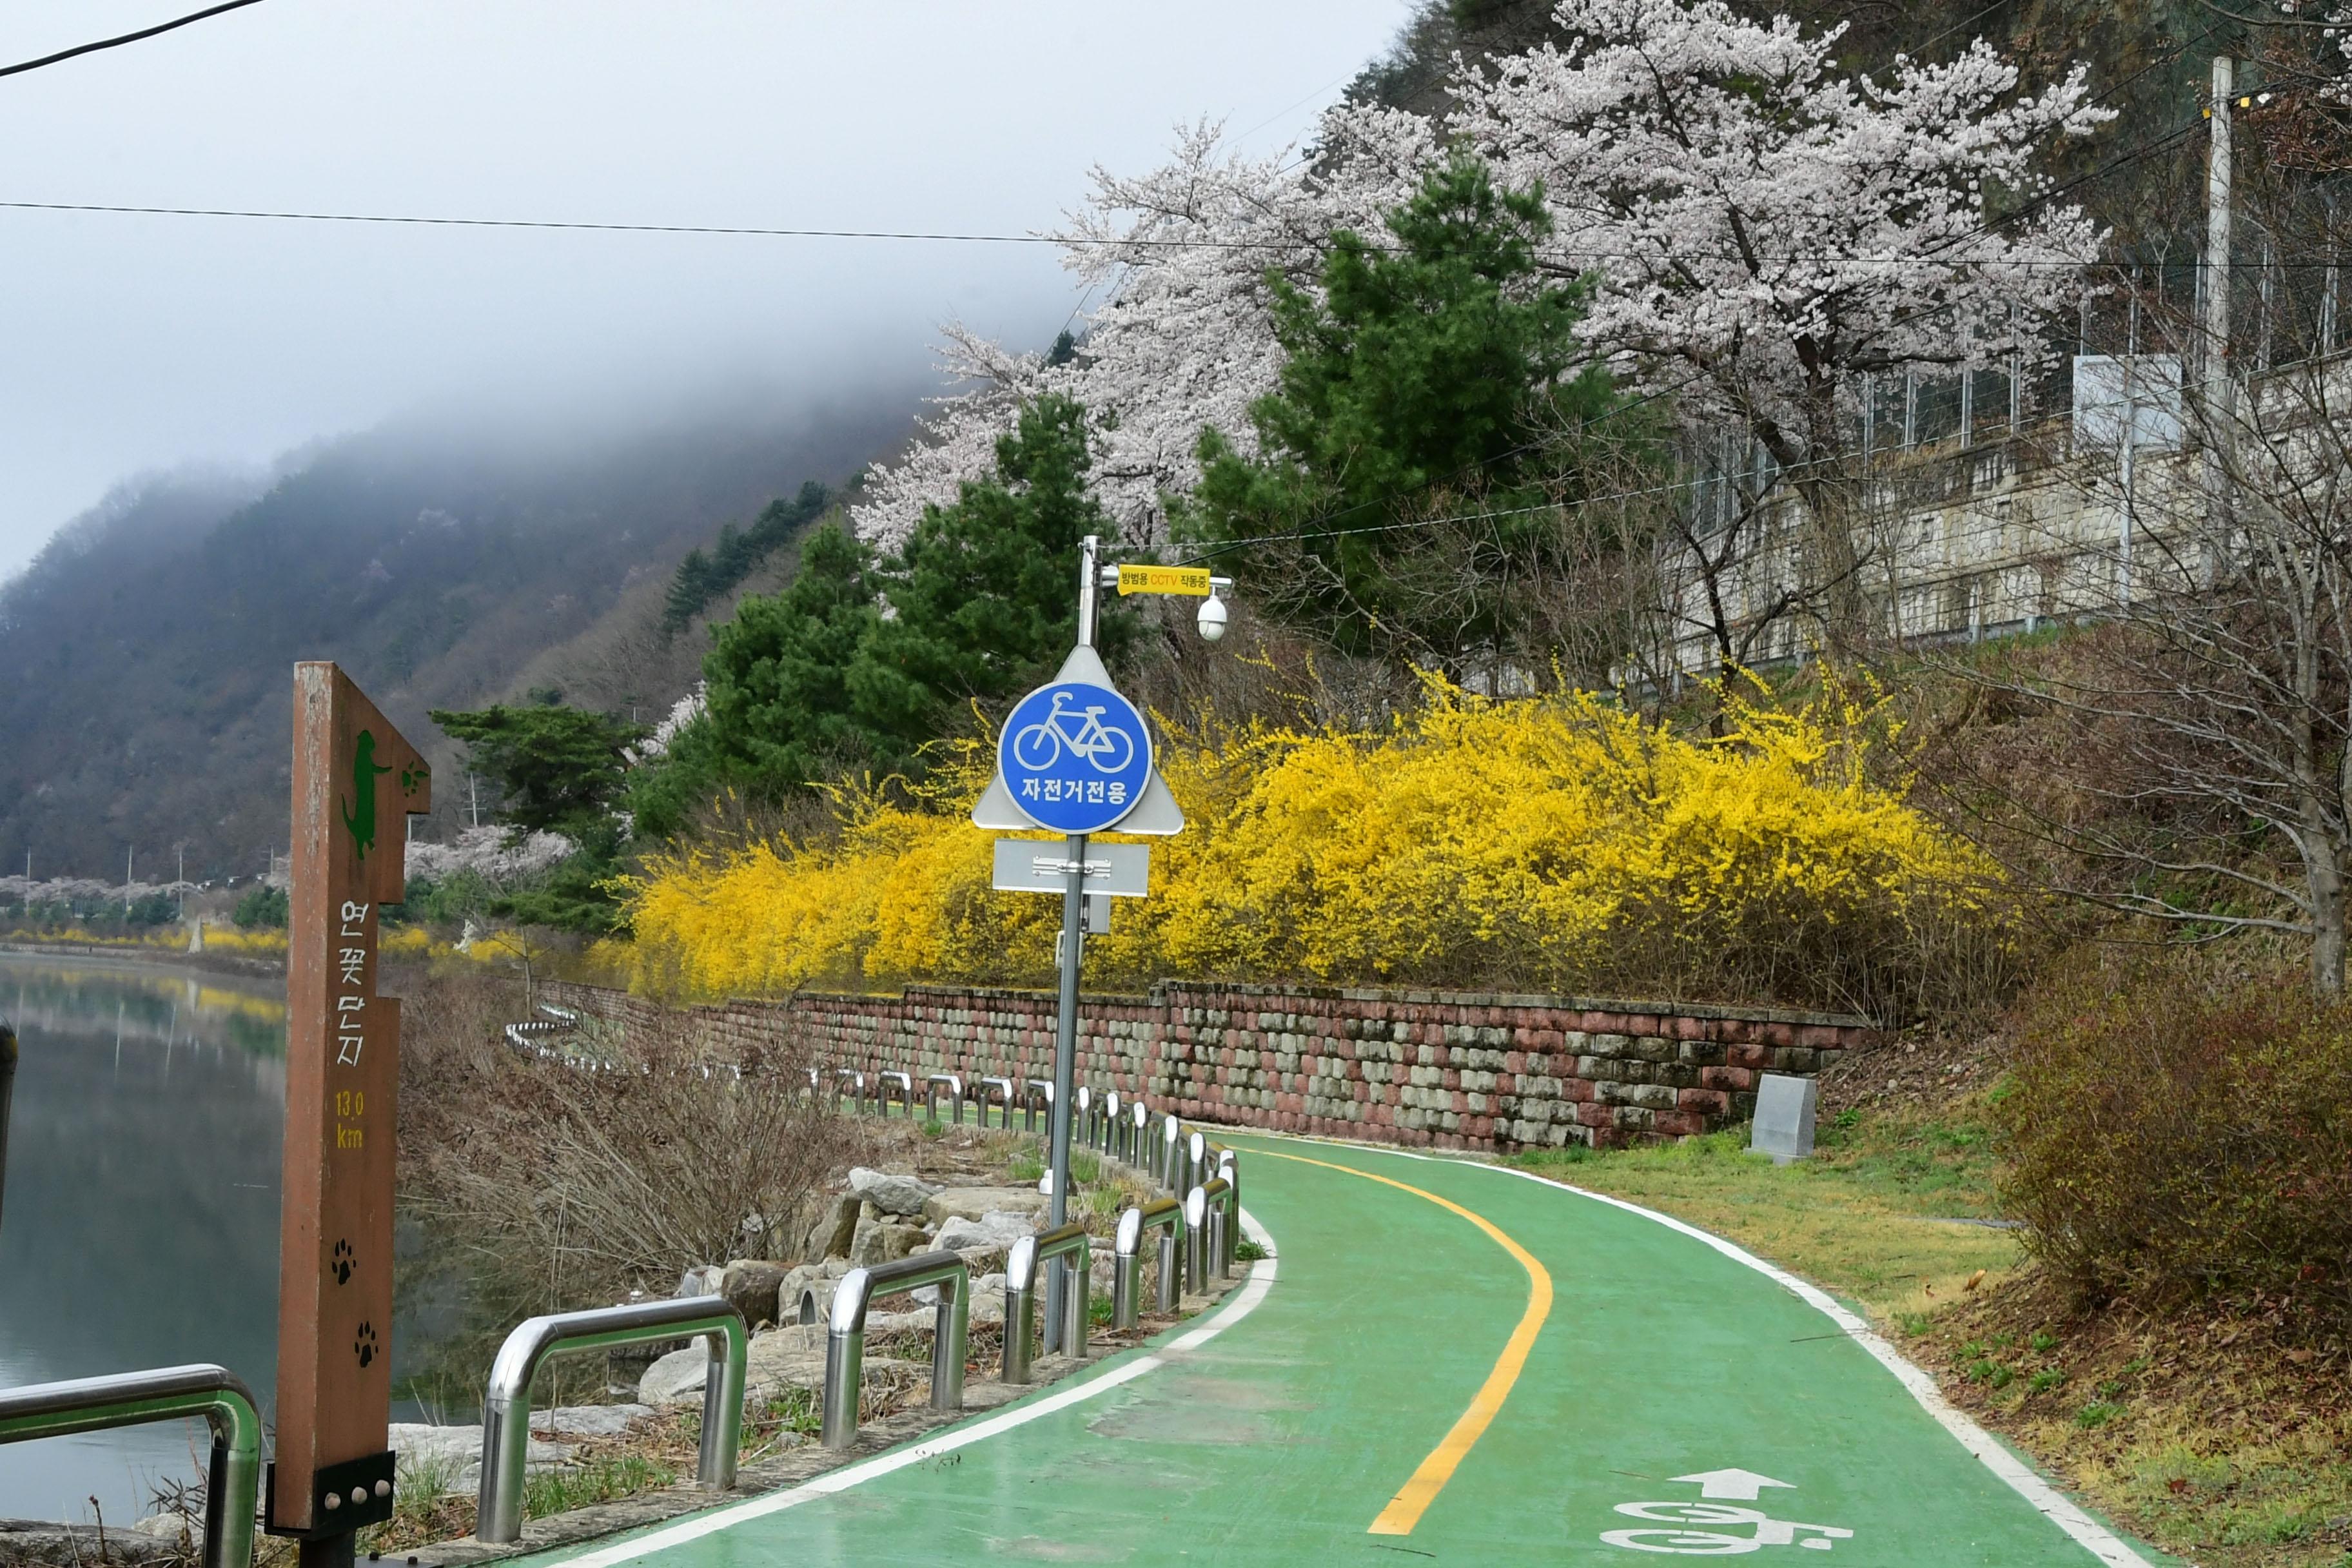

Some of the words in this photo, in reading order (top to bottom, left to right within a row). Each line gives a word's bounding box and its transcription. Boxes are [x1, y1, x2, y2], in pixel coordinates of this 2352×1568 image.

[1122, 572, 1148, 585] 방범용
[1150, 574, 1179, 586] CCTV
[1181, 574, 1206, 588] 작동중
[1021, 778, 1127, 805] 자전거전용
[337, 901, 369, 1067] 연꽃단지
[337, 1124, 362, 1149] km
